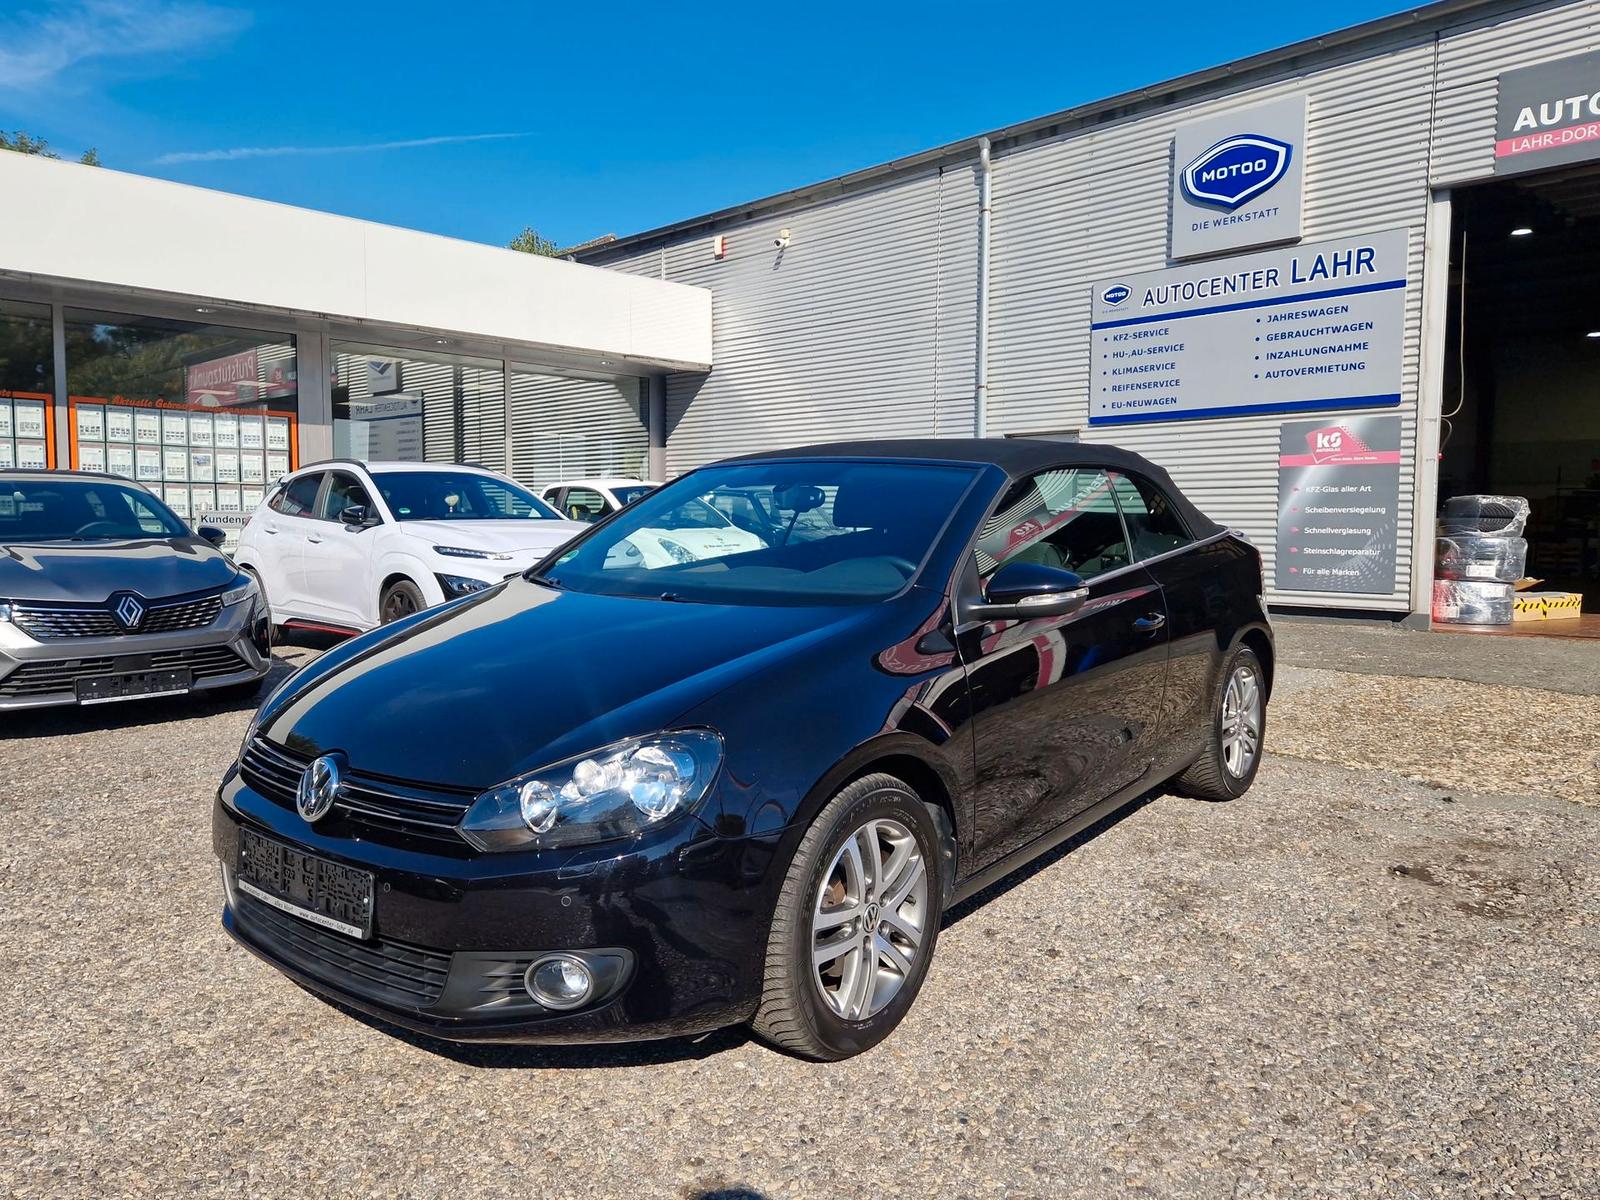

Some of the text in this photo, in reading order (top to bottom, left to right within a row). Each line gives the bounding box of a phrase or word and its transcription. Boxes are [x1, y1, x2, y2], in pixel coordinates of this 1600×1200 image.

[1511, 123, 1600, 153] LAHR-DOR
[1202, 158, 1267, 183] MOTOO
[1191, 207, 1279, 232] DIE WERKSTATT
[1142, 246, 1376, 308] AUTOCENTER LAHR
[1266, 305, 1349, 323] JAHRESWAGEN
[1113, 327, 1170, 342] KFZ-SERVICE
[1266, 321, 1374, 342] GEBRAUCHTWAGEN
[1266, 341, 1369, 360] INZAHLUNGNAHME
[1112, 362, 1176, 376] KLIMASERVICE
[1265, 361, 1366, 379] AUTOVERMIETUNG
[1111, 378, 1181, 393] REIFENSERVICE
[1111, 396, 1177, 409] EU-NEUWAGEN
[1341, 485, 1358, 493] aller
[1304, 506, 1387, 515] Scheibenversiegelung
[1303, 526, 1372, 536] Schnellverglasung
[1303, 547, 1381, 556] Steinschlagreparatur
[1302, 567, 1315, 575] Für
[1332, 568, 1360, 576] Marken
